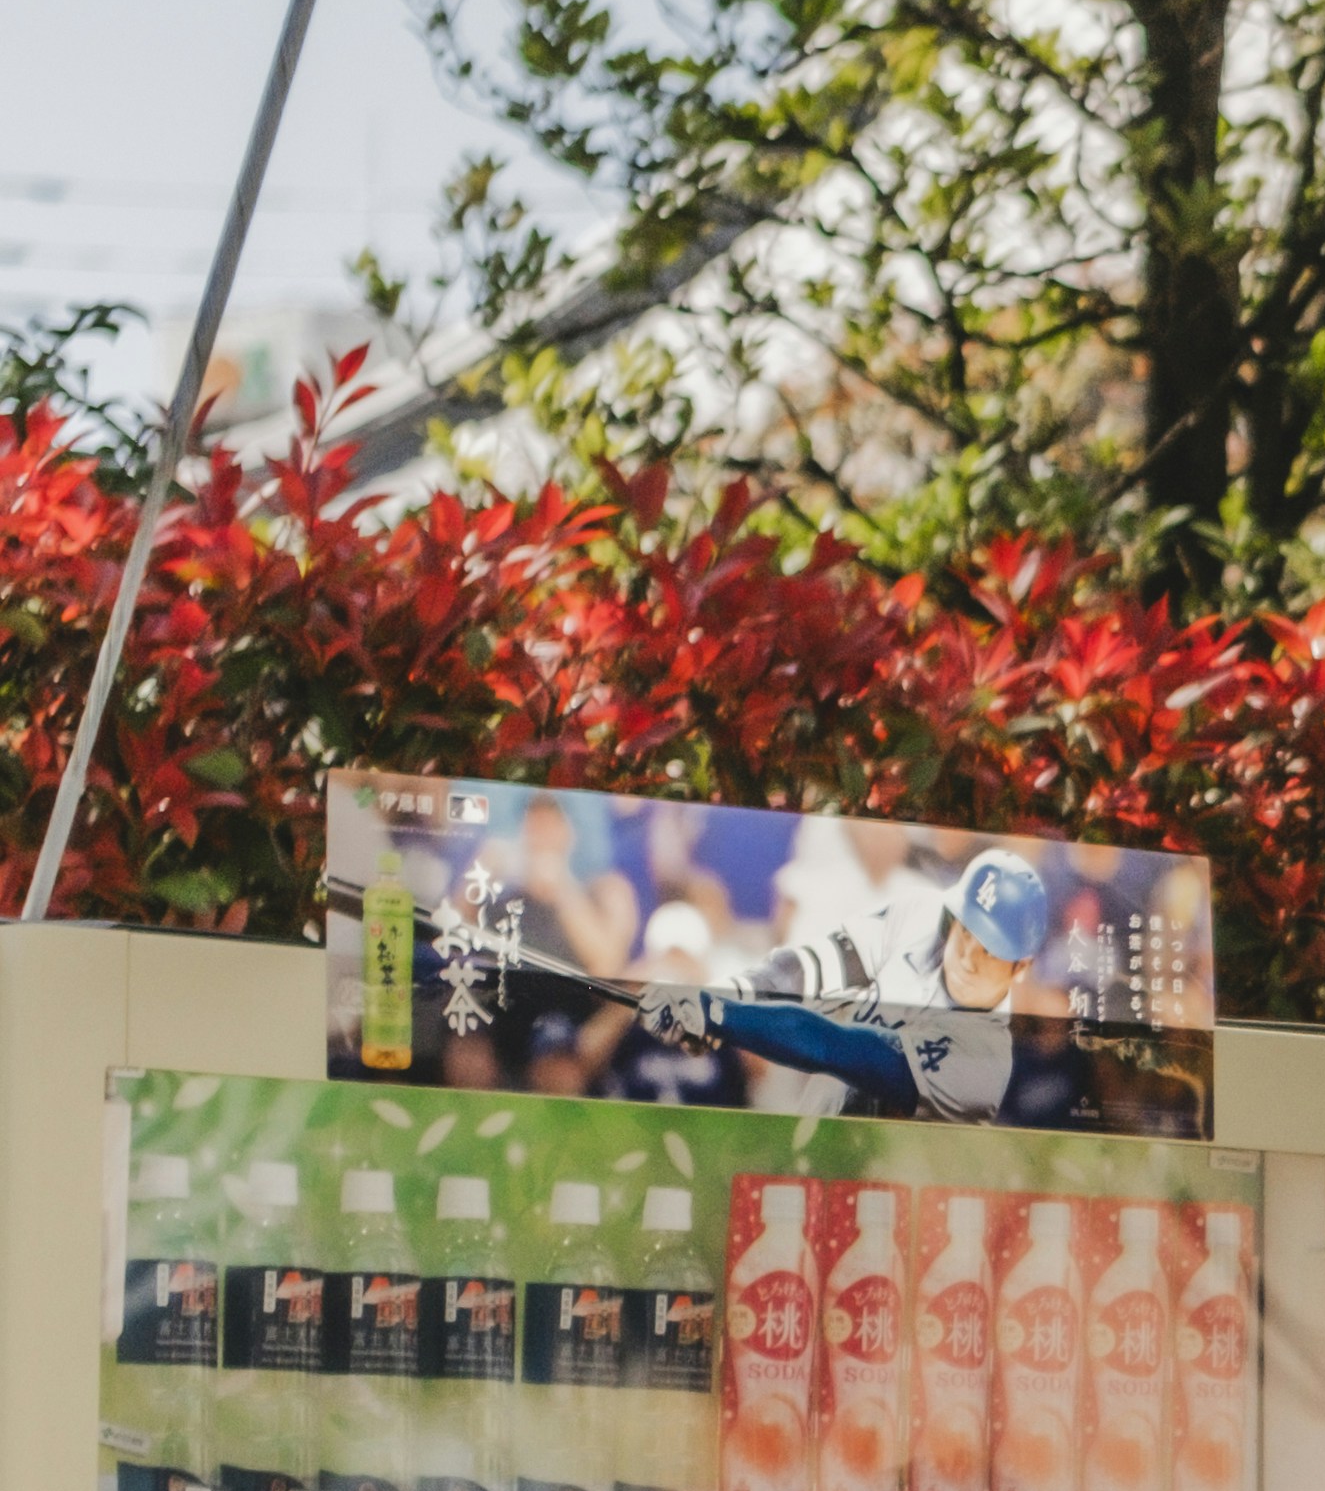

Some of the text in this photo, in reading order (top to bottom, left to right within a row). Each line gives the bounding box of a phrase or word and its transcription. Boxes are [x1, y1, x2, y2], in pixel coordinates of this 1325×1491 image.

[380, 792, 433, 815] 伊藤園
[431, 899, 494, 1037] お茶
[1066, 918, 1089, 974] 大谷
[1128, 912, 1144, 1021] お茶がある。
[758, 1302, 801, 1350] 桃
[854, 1306, 893, 1354] 桃
[948, 1311, 984, 1358] 桃
[1029, 1315, 1070, 1363] 桃
[1121, 1320, 1158, 1367] 桃
[1207, 1323, 1241, 1369] 桃
